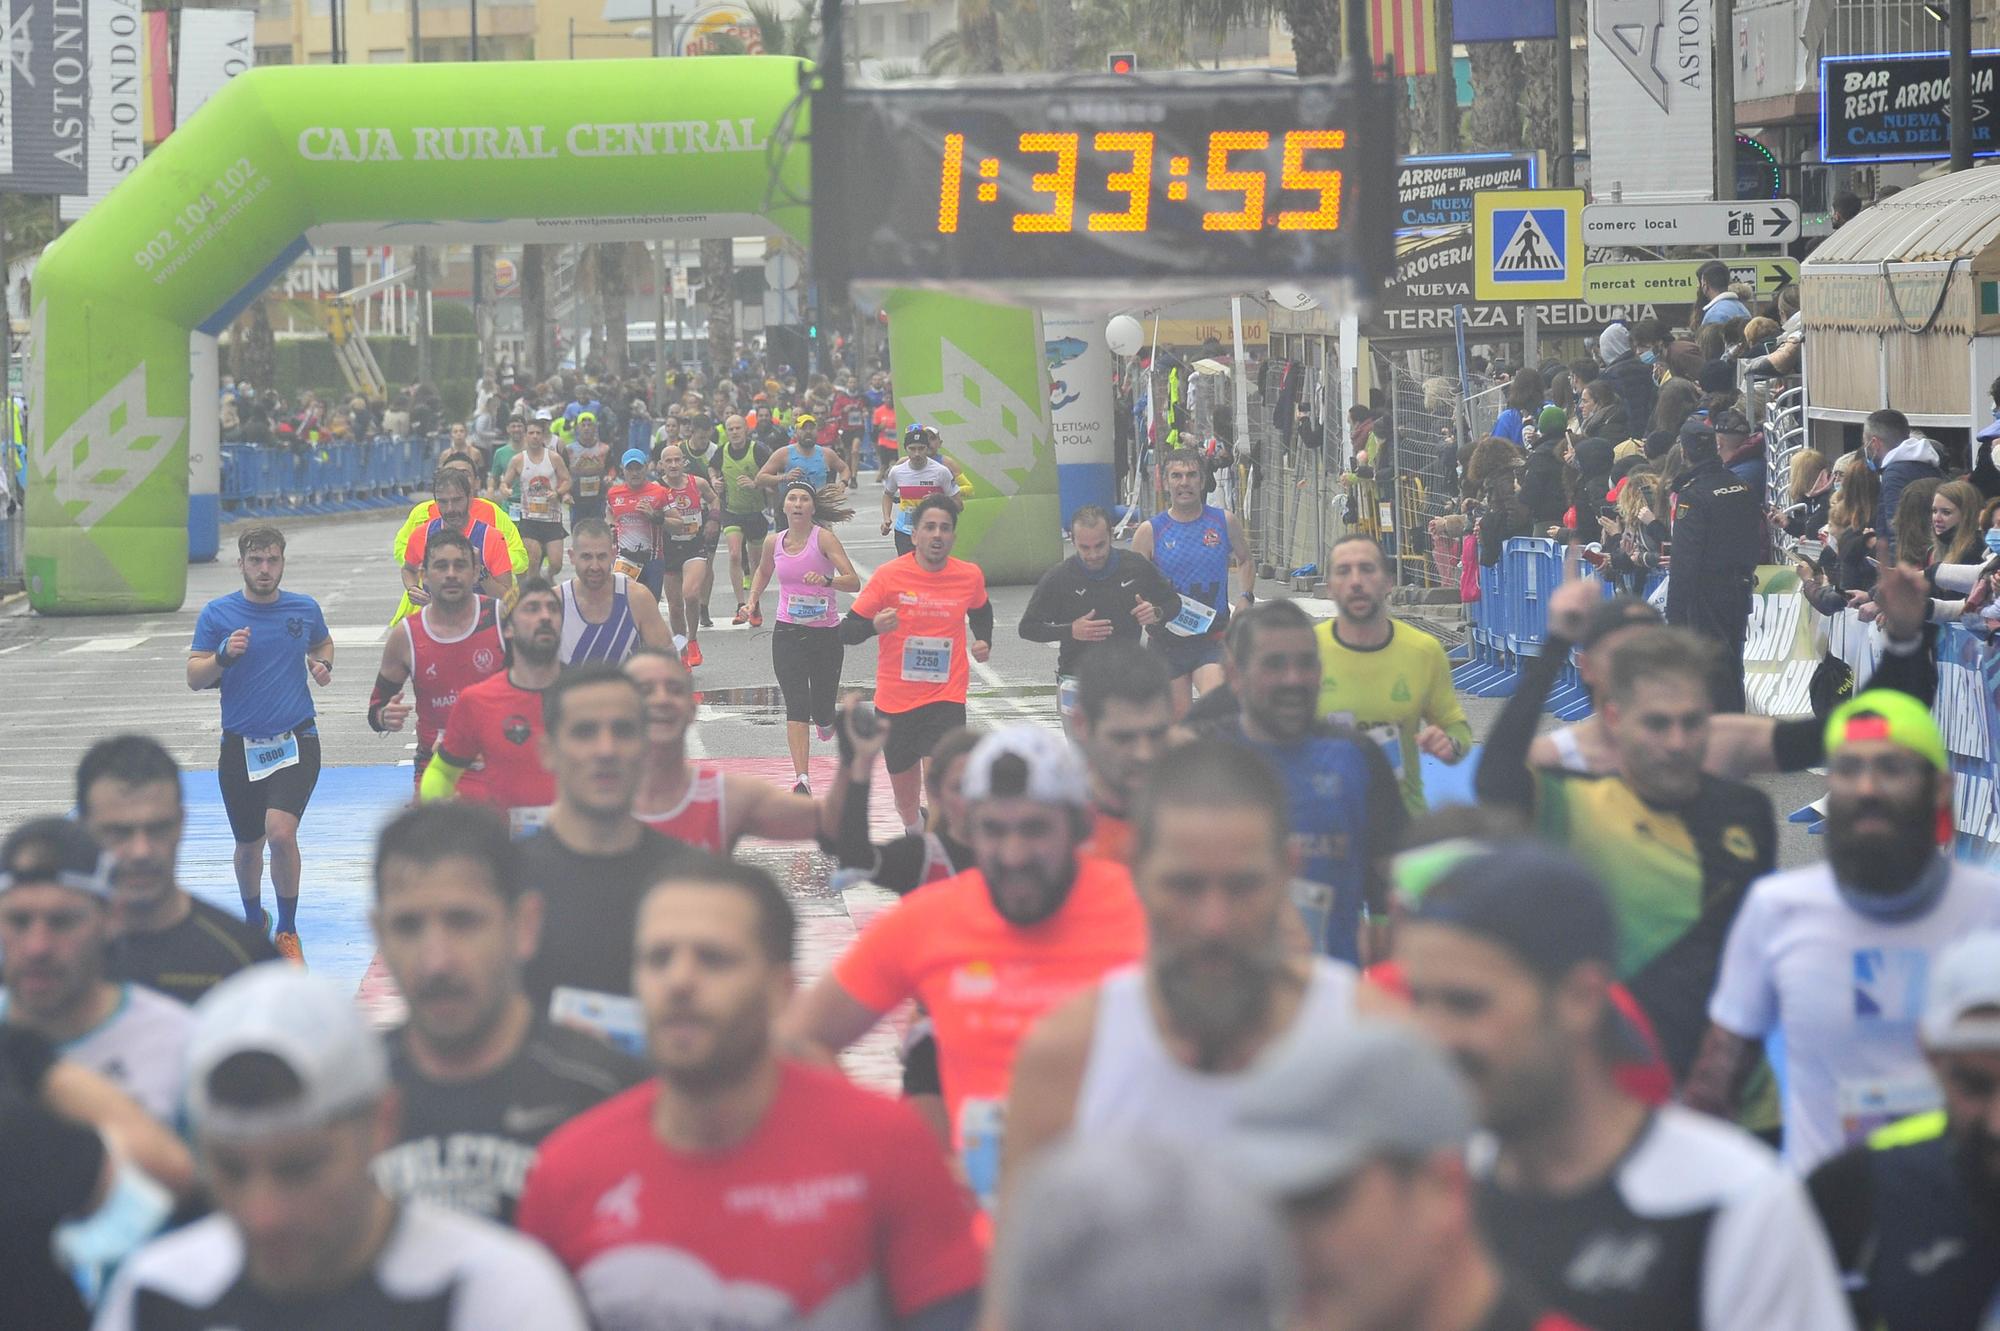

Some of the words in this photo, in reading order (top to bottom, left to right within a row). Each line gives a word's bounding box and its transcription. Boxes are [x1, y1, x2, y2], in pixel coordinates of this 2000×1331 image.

[1843, 71, 1890, 93] BAR
[1844, 90, 1889, 120] REST.
[1884, 112, 1942, 128] NUEVA
[298, 127, 404, 162] CAJA
[411, 125, 560, 161] RURAL
[566, 118, 768, 157] CENTRAL
[1905, 128, 1942, 142] DEL
[938, 129, 1346, 233] 1:33:55
[1397, 167, 1467, 187] ARROCERIA
[1398, 182, 1447, 204] TAPERIA
[1459, 167, 1522, 192] FREIDURIA
[134, 228, 180, 272] 902
[175, 194, 218, 236] 104
[215, 156, 259, 198] 102
[1588, 220, 1637, 231] comerç
[1644, 218, 1678, 230] local
[1406, 282, 1471, 296] NUEVA
[1590, 278, 1636, 290] mercat
[1644, 276, 1693, 289] central
[1383, 305, 1509, 330] TERRAZA
